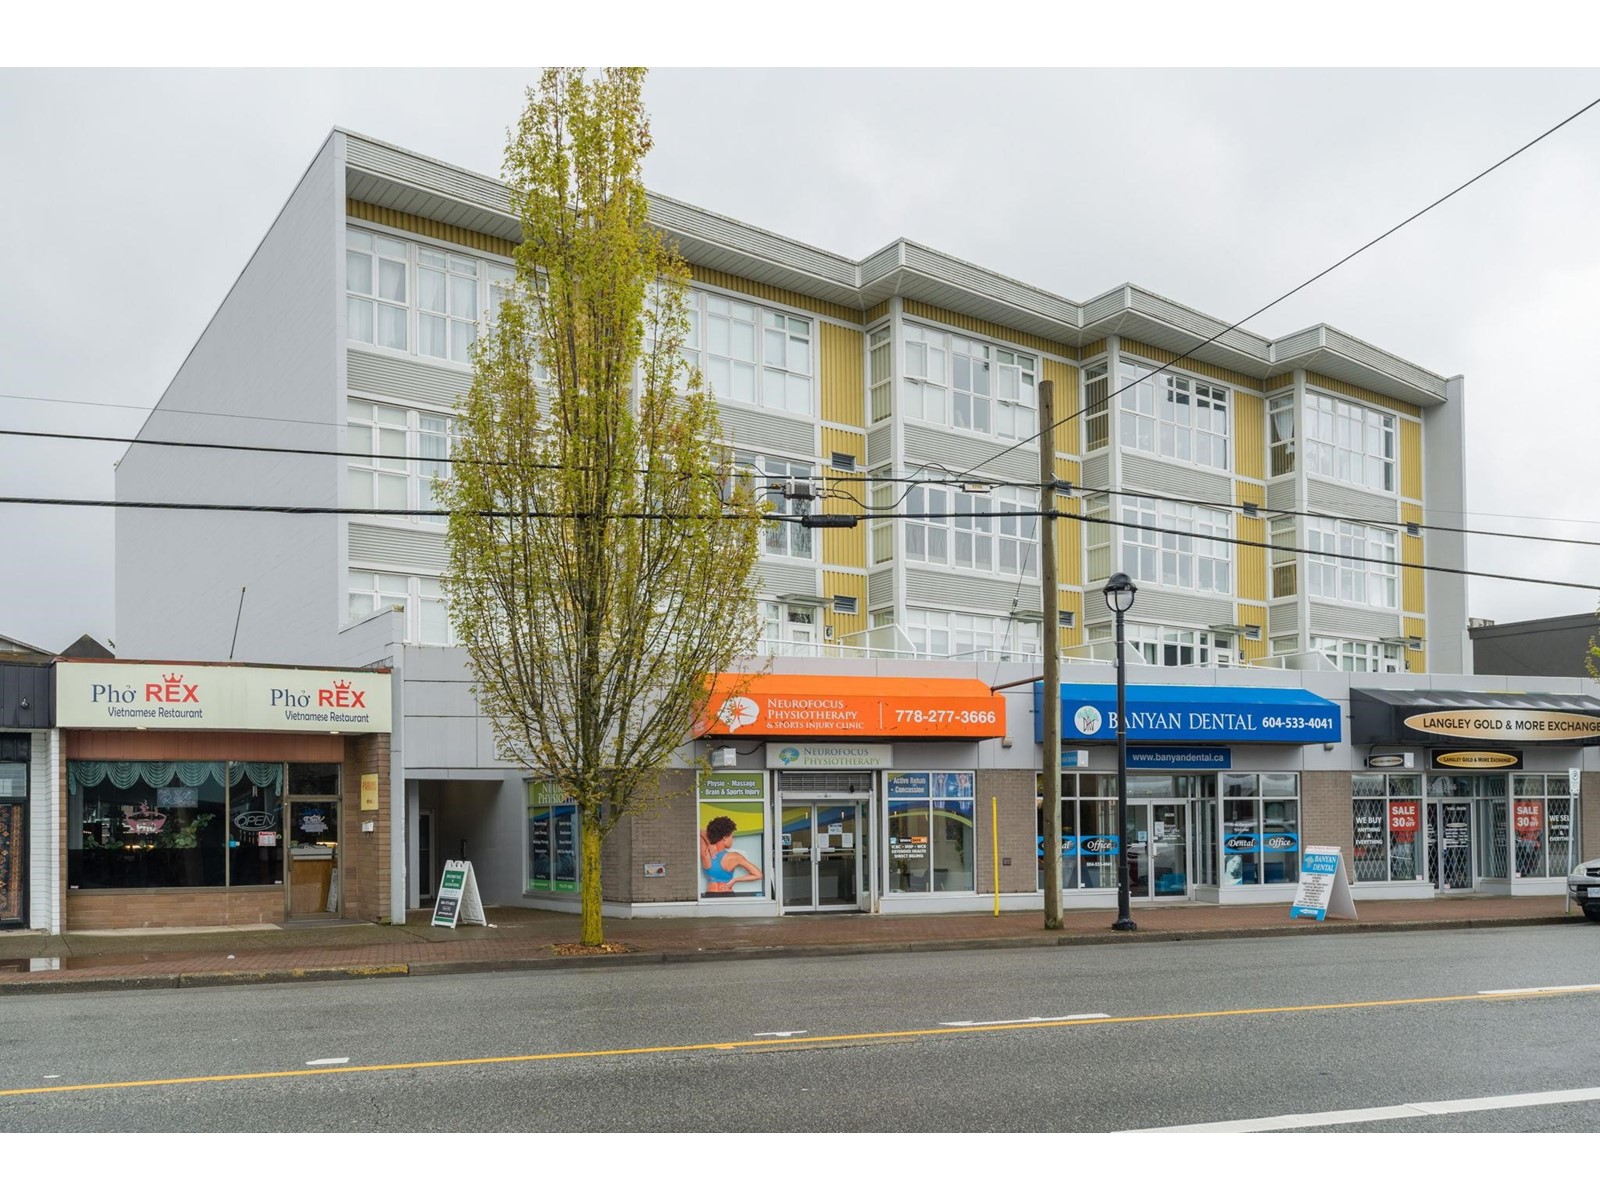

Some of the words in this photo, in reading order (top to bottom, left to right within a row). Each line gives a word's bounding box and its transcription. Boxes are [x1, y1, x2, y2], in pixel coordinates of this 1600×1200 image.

[91, 684, 137, 704] Phở
[145, 683, 199, 703] REX
[270, 688, 311, 708] Phở
[318, 689, 366, 709] REX
[767, 698, 844, 709] NEUROFOCUS
[108, 706, 156, 718] Vietnamese
[158, 707, 203, 718] Restaurant
[285, 710, 328, 722] Vietnamese
[330, 711, 369, 723] Restaurant
[767, 709, 858, 720] PHYSIOTHERAPY
[895, 709, 996, 724] 778-277-3666
[835, 722, 865, 730] CLINIC
[1189, 713, 1257, 731] DENTAL
[1262, 716, 1333, 729] 604-533-4041
[1423, 718, 1471, 729] LANGLEY
[1473, 719, 1503, 730] GOLD
[1505, 720, 1513, 730] &
[1515, 720, 1545, 731] MORE
[804, 747, 869, 756] NEUROFOCUS
[804, 757, 880, 766] PHYSIOTHERAPY
[1132, 753, 1224, 764] www.banyandental.ca
[727, 788, 743, 796] Sports
[1392, 806, 1415, 815] SALE
[1517, 807, 1538, 815] SALE
[236, 815, 274, 826] OPEN
[1392, 817, 1405, 827] 30
[1517, 817, 1529, 827] 30
[1087, 840, 1112, 852] Office
[1228, 838, 1255, 847] Dental
[1268, 838, 1291, 849] Office
[1315, 855, 1337, 863] BANYAN
[1313, 864, 1334, 872] DENTAL
